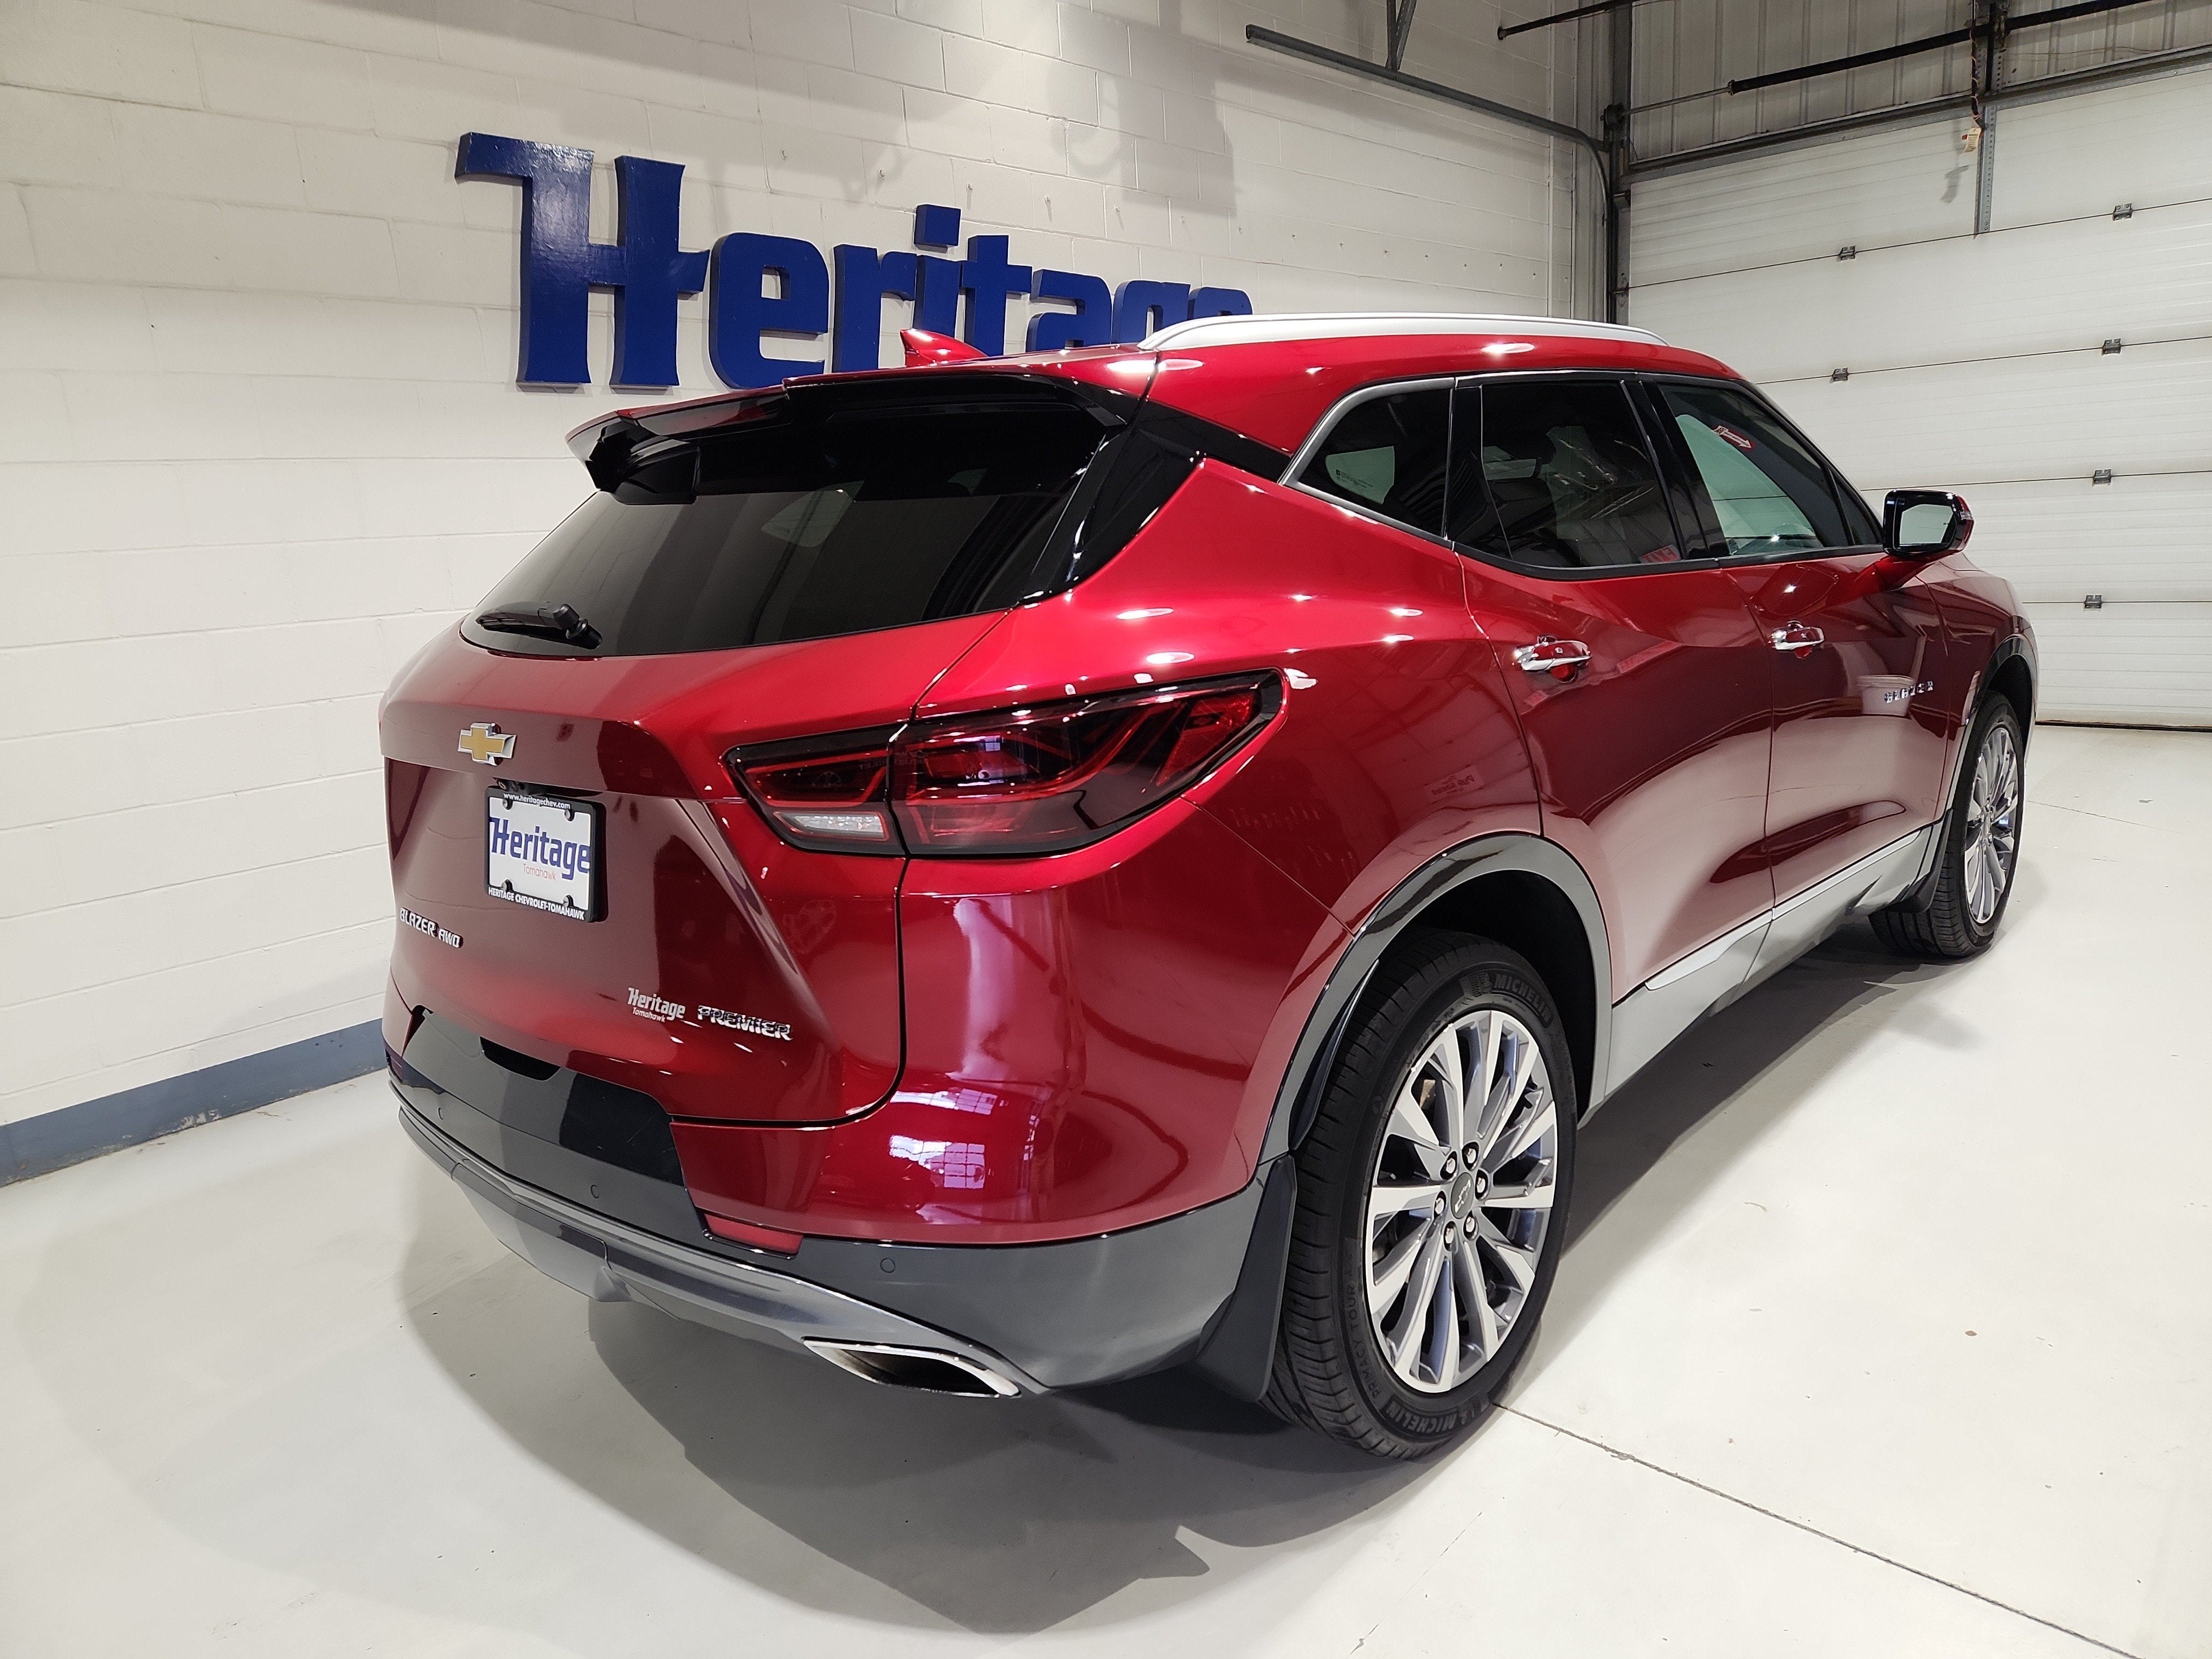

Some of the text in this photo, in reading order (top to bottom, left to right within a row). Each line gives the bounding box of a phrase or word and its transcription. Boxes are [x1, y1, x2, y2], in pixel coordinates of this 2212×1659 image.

[454, 132, 1253, 388] Herita
[504, 793, 571, 809] www.heritagechev.com
[489, 816, 590, 880] Heritage
[523, 863, 557, 881] Tomahawk
[488, 886, 515, 902] HERITAGE
[400, 907, 461, 948] BLAZER AWD
[627, 987, 686, 1021] Heritage
[632, 1007, 666, 1023] Tomahawk
[1494, 973, 1552, 1023] MICHELIN
[697, 1005, 793, 1040] PREMIER
[1386, 1400, 1458, 1433] MICHELIN
